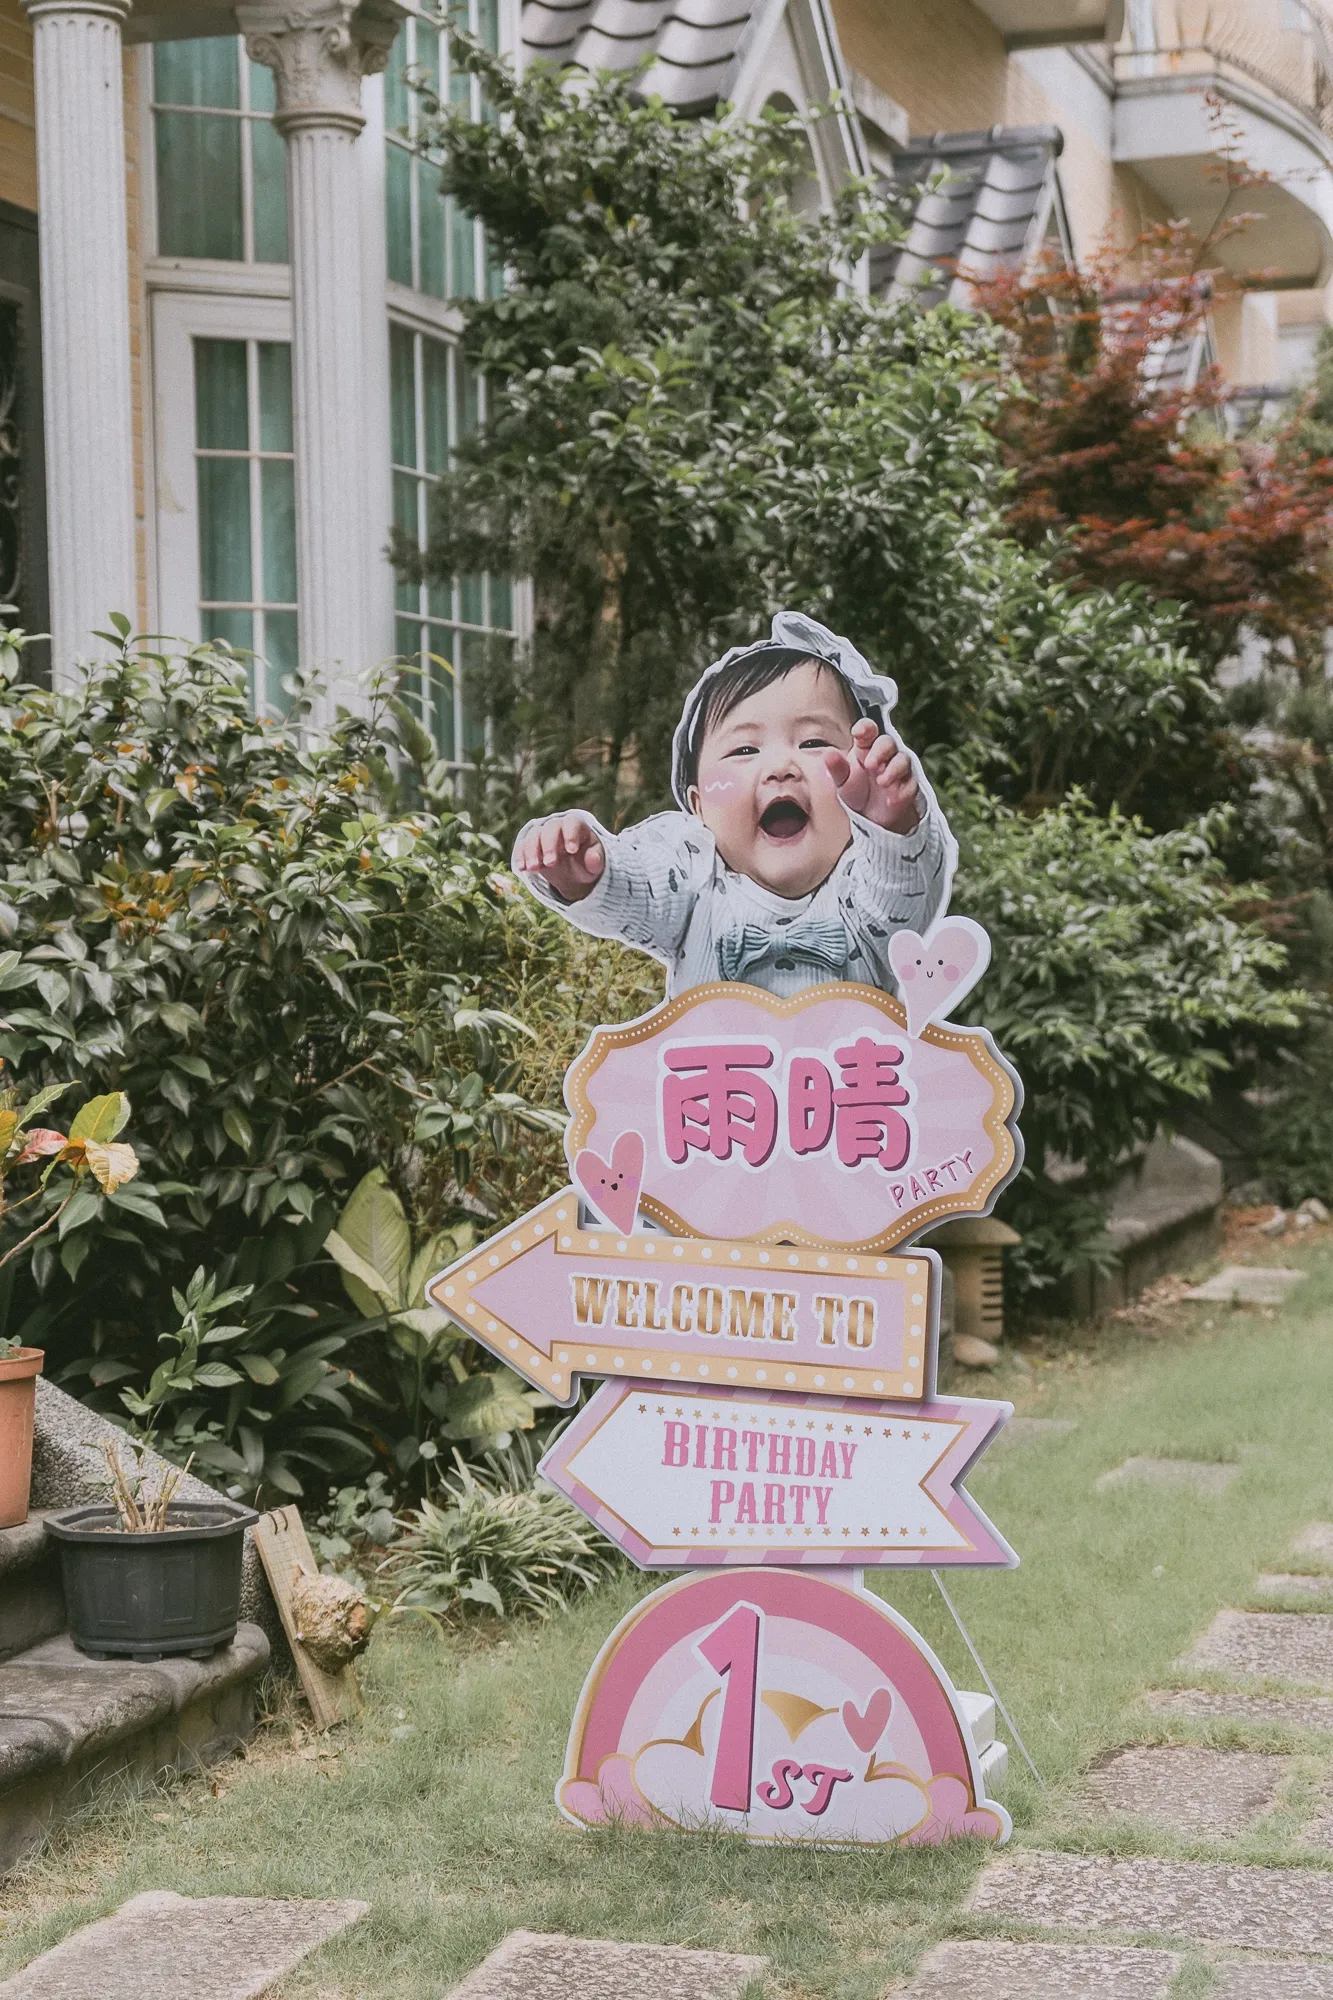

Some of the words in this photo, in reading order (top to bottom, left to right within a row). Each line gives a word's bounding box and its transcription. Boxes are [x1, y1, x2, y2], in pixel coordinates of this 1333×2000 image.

[662, 1036, 911, 1171] 雨晴
[888, 1149, 975, 1208] PARTY
[571, 1275, 798, 1343] WELCOME
[813, 1294, 876, 1349] TO
[661, 1421, 859, 1479] BIRTHDAY
[708, 1480, 834, 1525] PARTY
